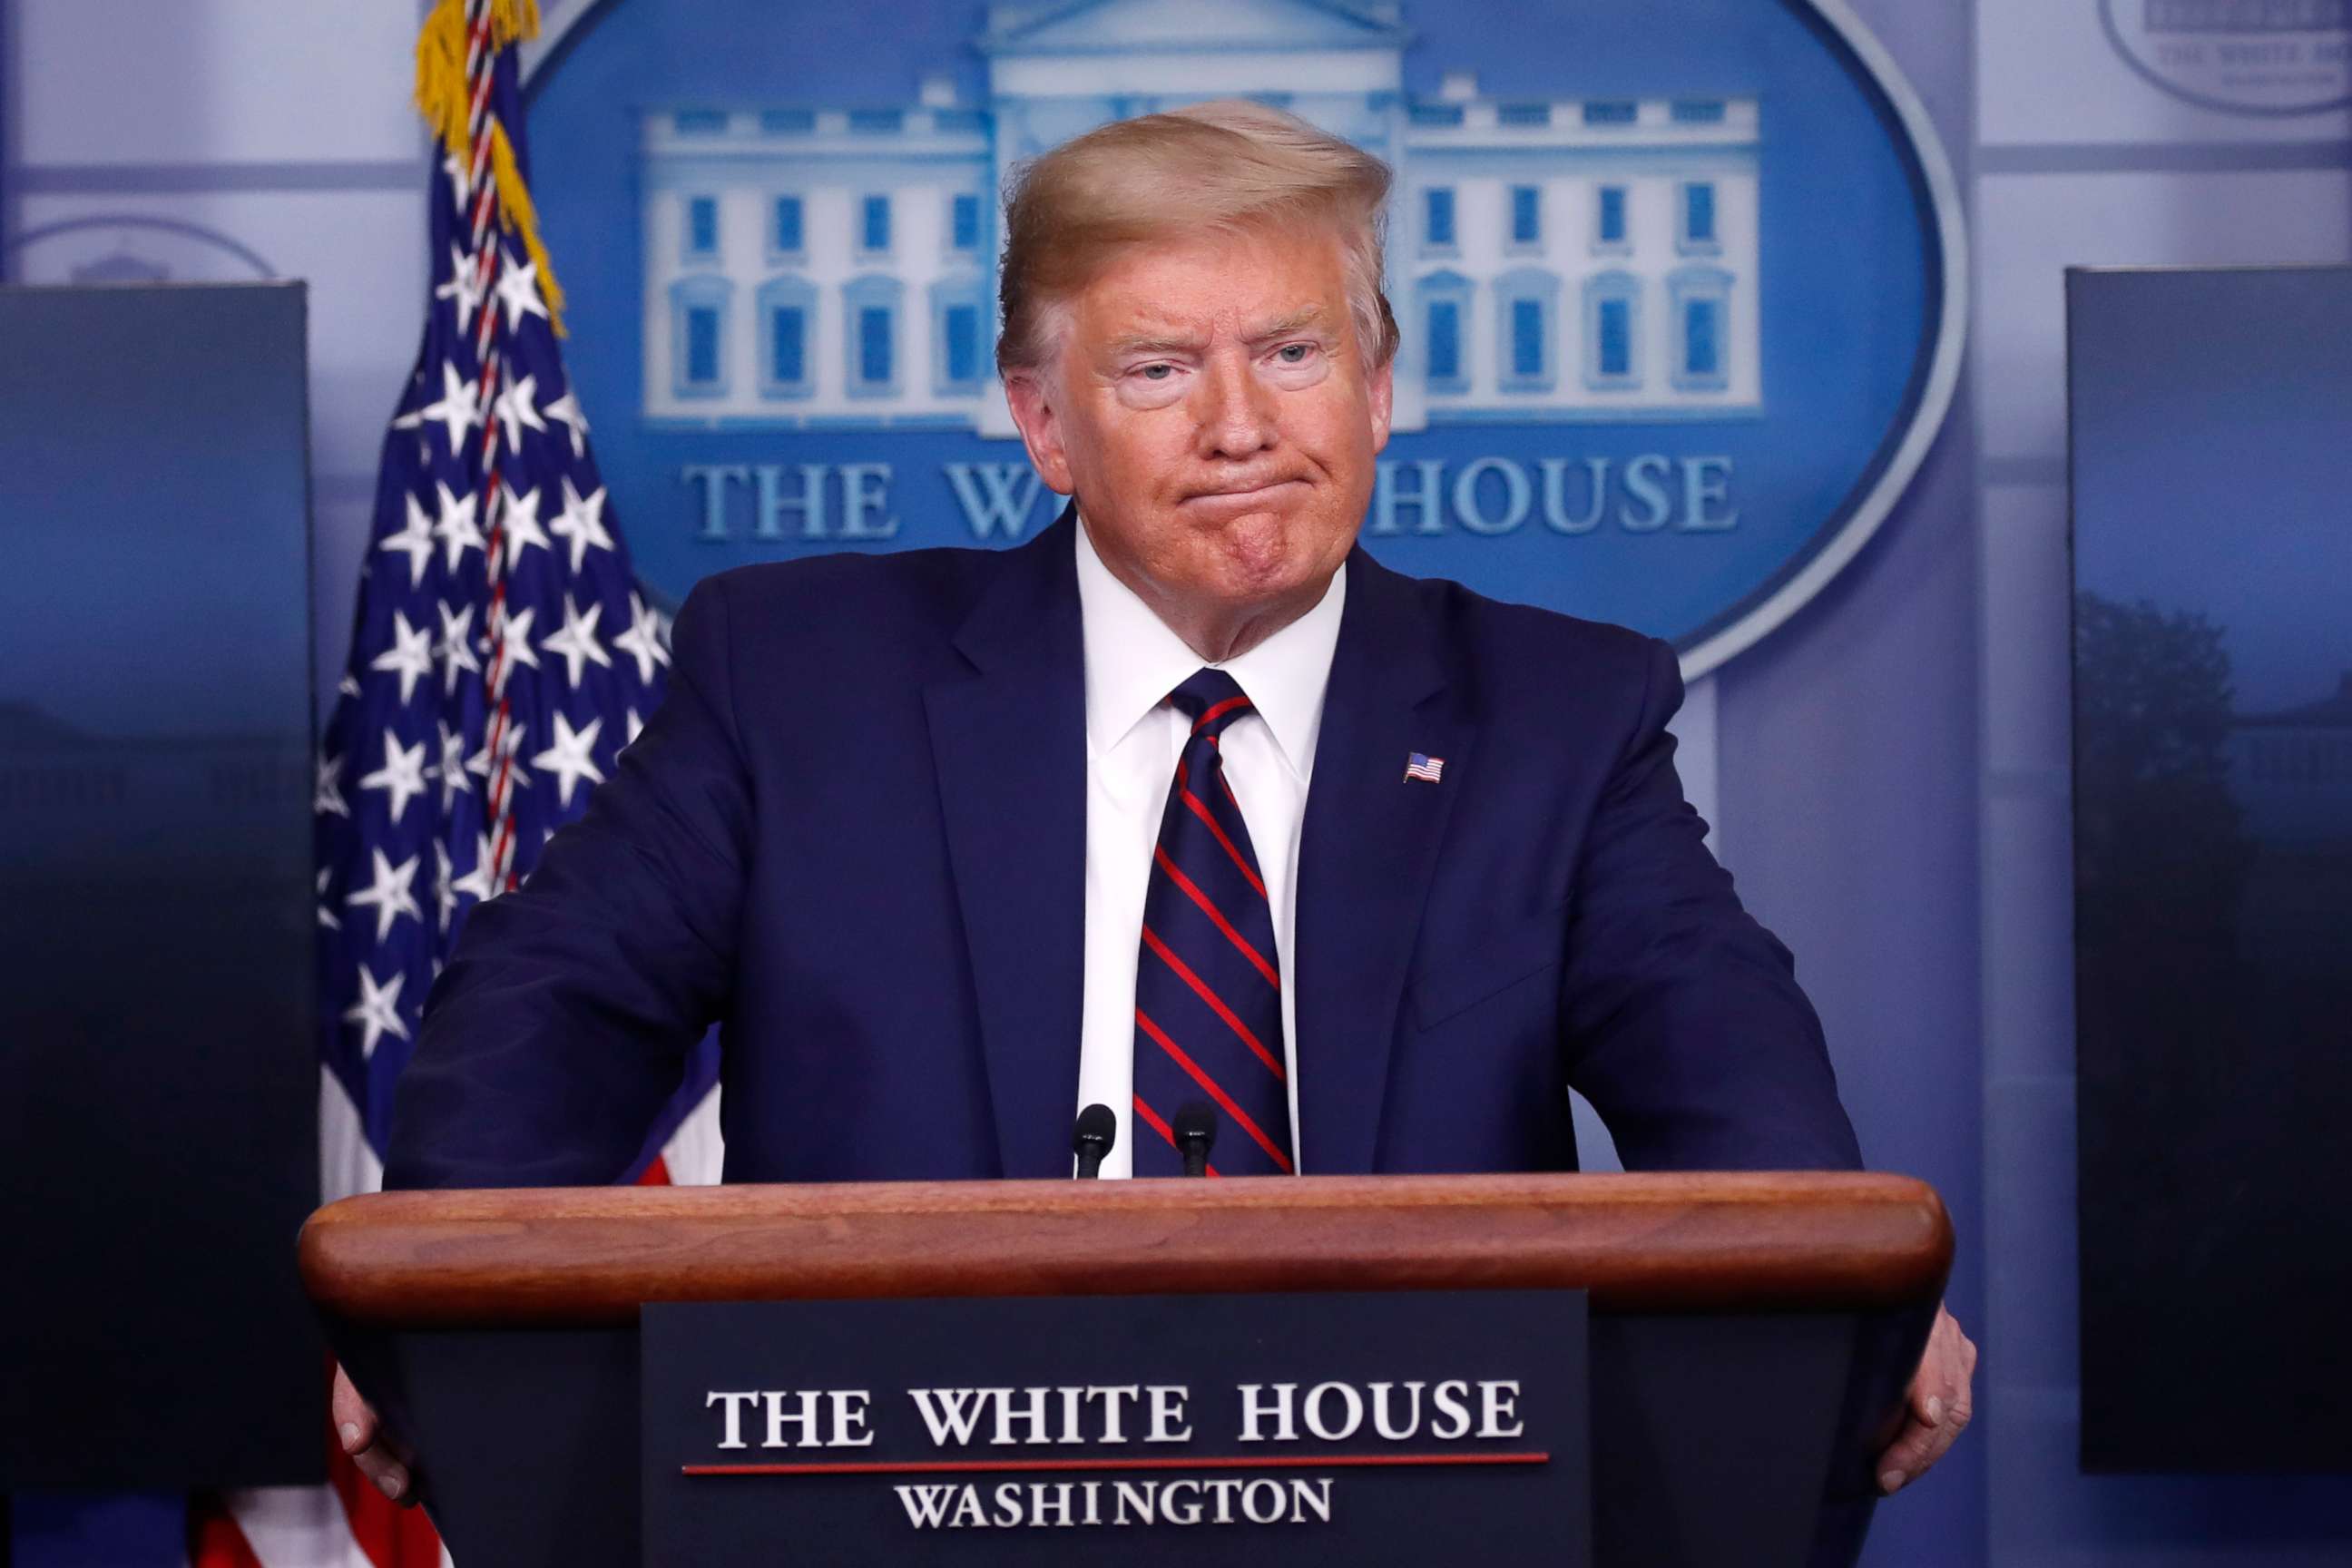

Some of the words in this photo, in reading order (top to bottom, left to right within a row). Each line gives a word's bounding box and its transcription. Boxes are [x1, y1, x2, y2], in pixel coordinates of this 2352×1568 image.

[681, 463, 898, 539] THE
[1368, 455, 1740, 535] HOUSE
[706, 1389, 875, 1449] THE
[906, 1384, 1192, 1446] WHITE
[1237, 1379, 1524, 1441] HOUSE
[893, 1478, 1333, 1529] WASHINGTON
